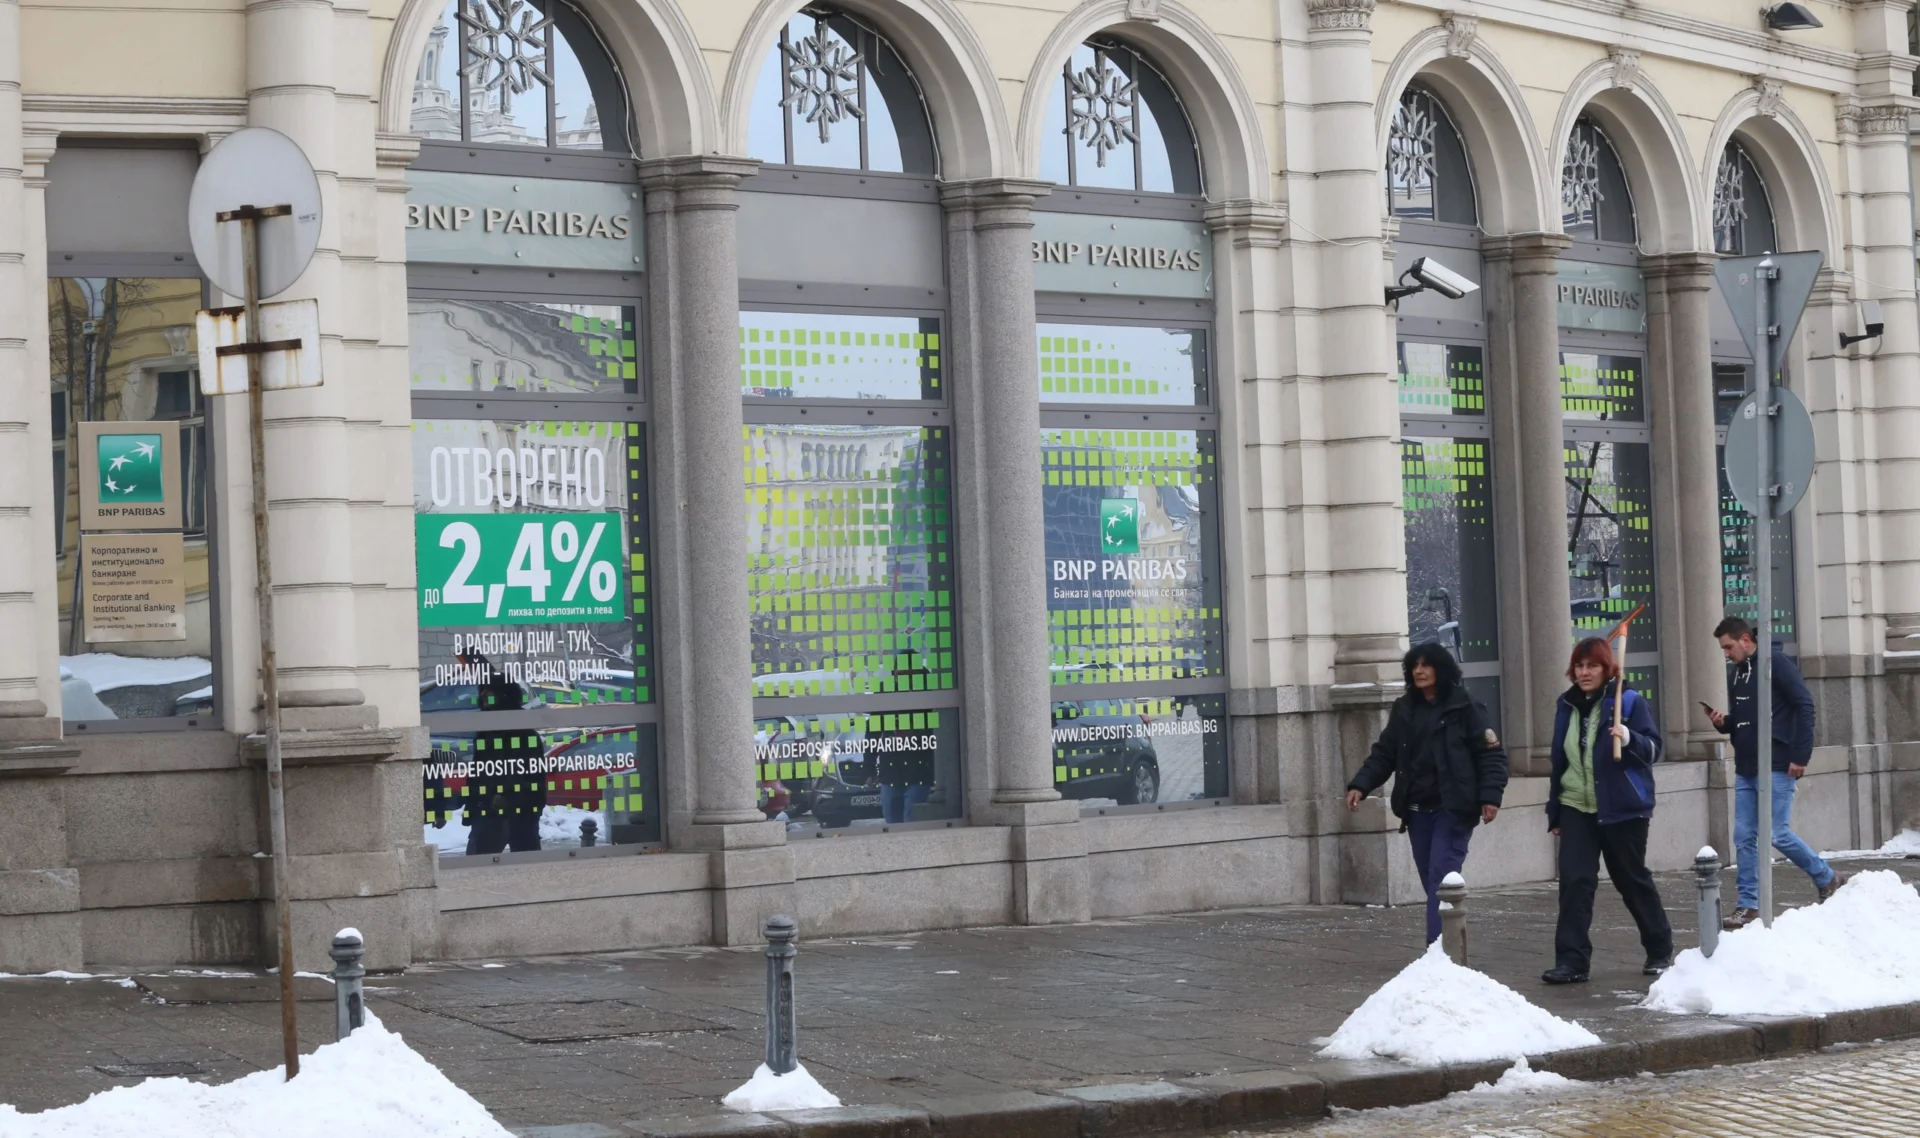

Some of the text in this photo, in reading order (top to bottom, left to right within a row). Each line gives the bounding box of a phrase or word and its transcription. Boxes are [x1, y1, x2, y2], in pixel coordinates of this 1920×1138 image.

[405, 203, 629, 239] BNP PARIBAS
[1088, 243, 1200, 271] PARIBAS
[1574, 286, 1640, 310] PARIBAS
[430, 446, 605, 507] ОТВОРЕНО
[122, 508, 165, 516] PARIBAS
[92, 547, 150, 556] Корпоративно
[92, 558, 164, 567] институционално
[439, 521, 616, 618] 2,4%
[1054, 559, 1187, 580] BNP PARIBAS
[92, 570, 136, 579] банкиране
[93, 594, 132, 603] Corporate
[1054, 587, 1089, 598] Банката
[1092, 590, 1101, 598] на
[1160, 589, 1170, 597] се
[1172, 588, 1187, 597] свят
[93, 604, 175, 613] Institutional Banking
[508, 608, 533, 616] лихва
[547, 607, 585, 617] депозити
[454, 634, 462, 655] В
[466, 632, 523, 655] РАБОТНИ
[526, 631, 554, 657] ДНИ
[567, 630, 594, 655] ТУК,
[435, 658, 490, 687] ОНЛАЙН
[505, 662, 522, 684] ПО
[525, 660, 565, 683] ВСЯКО
[570, 659, 613, 682] ВРЕМЕ.
